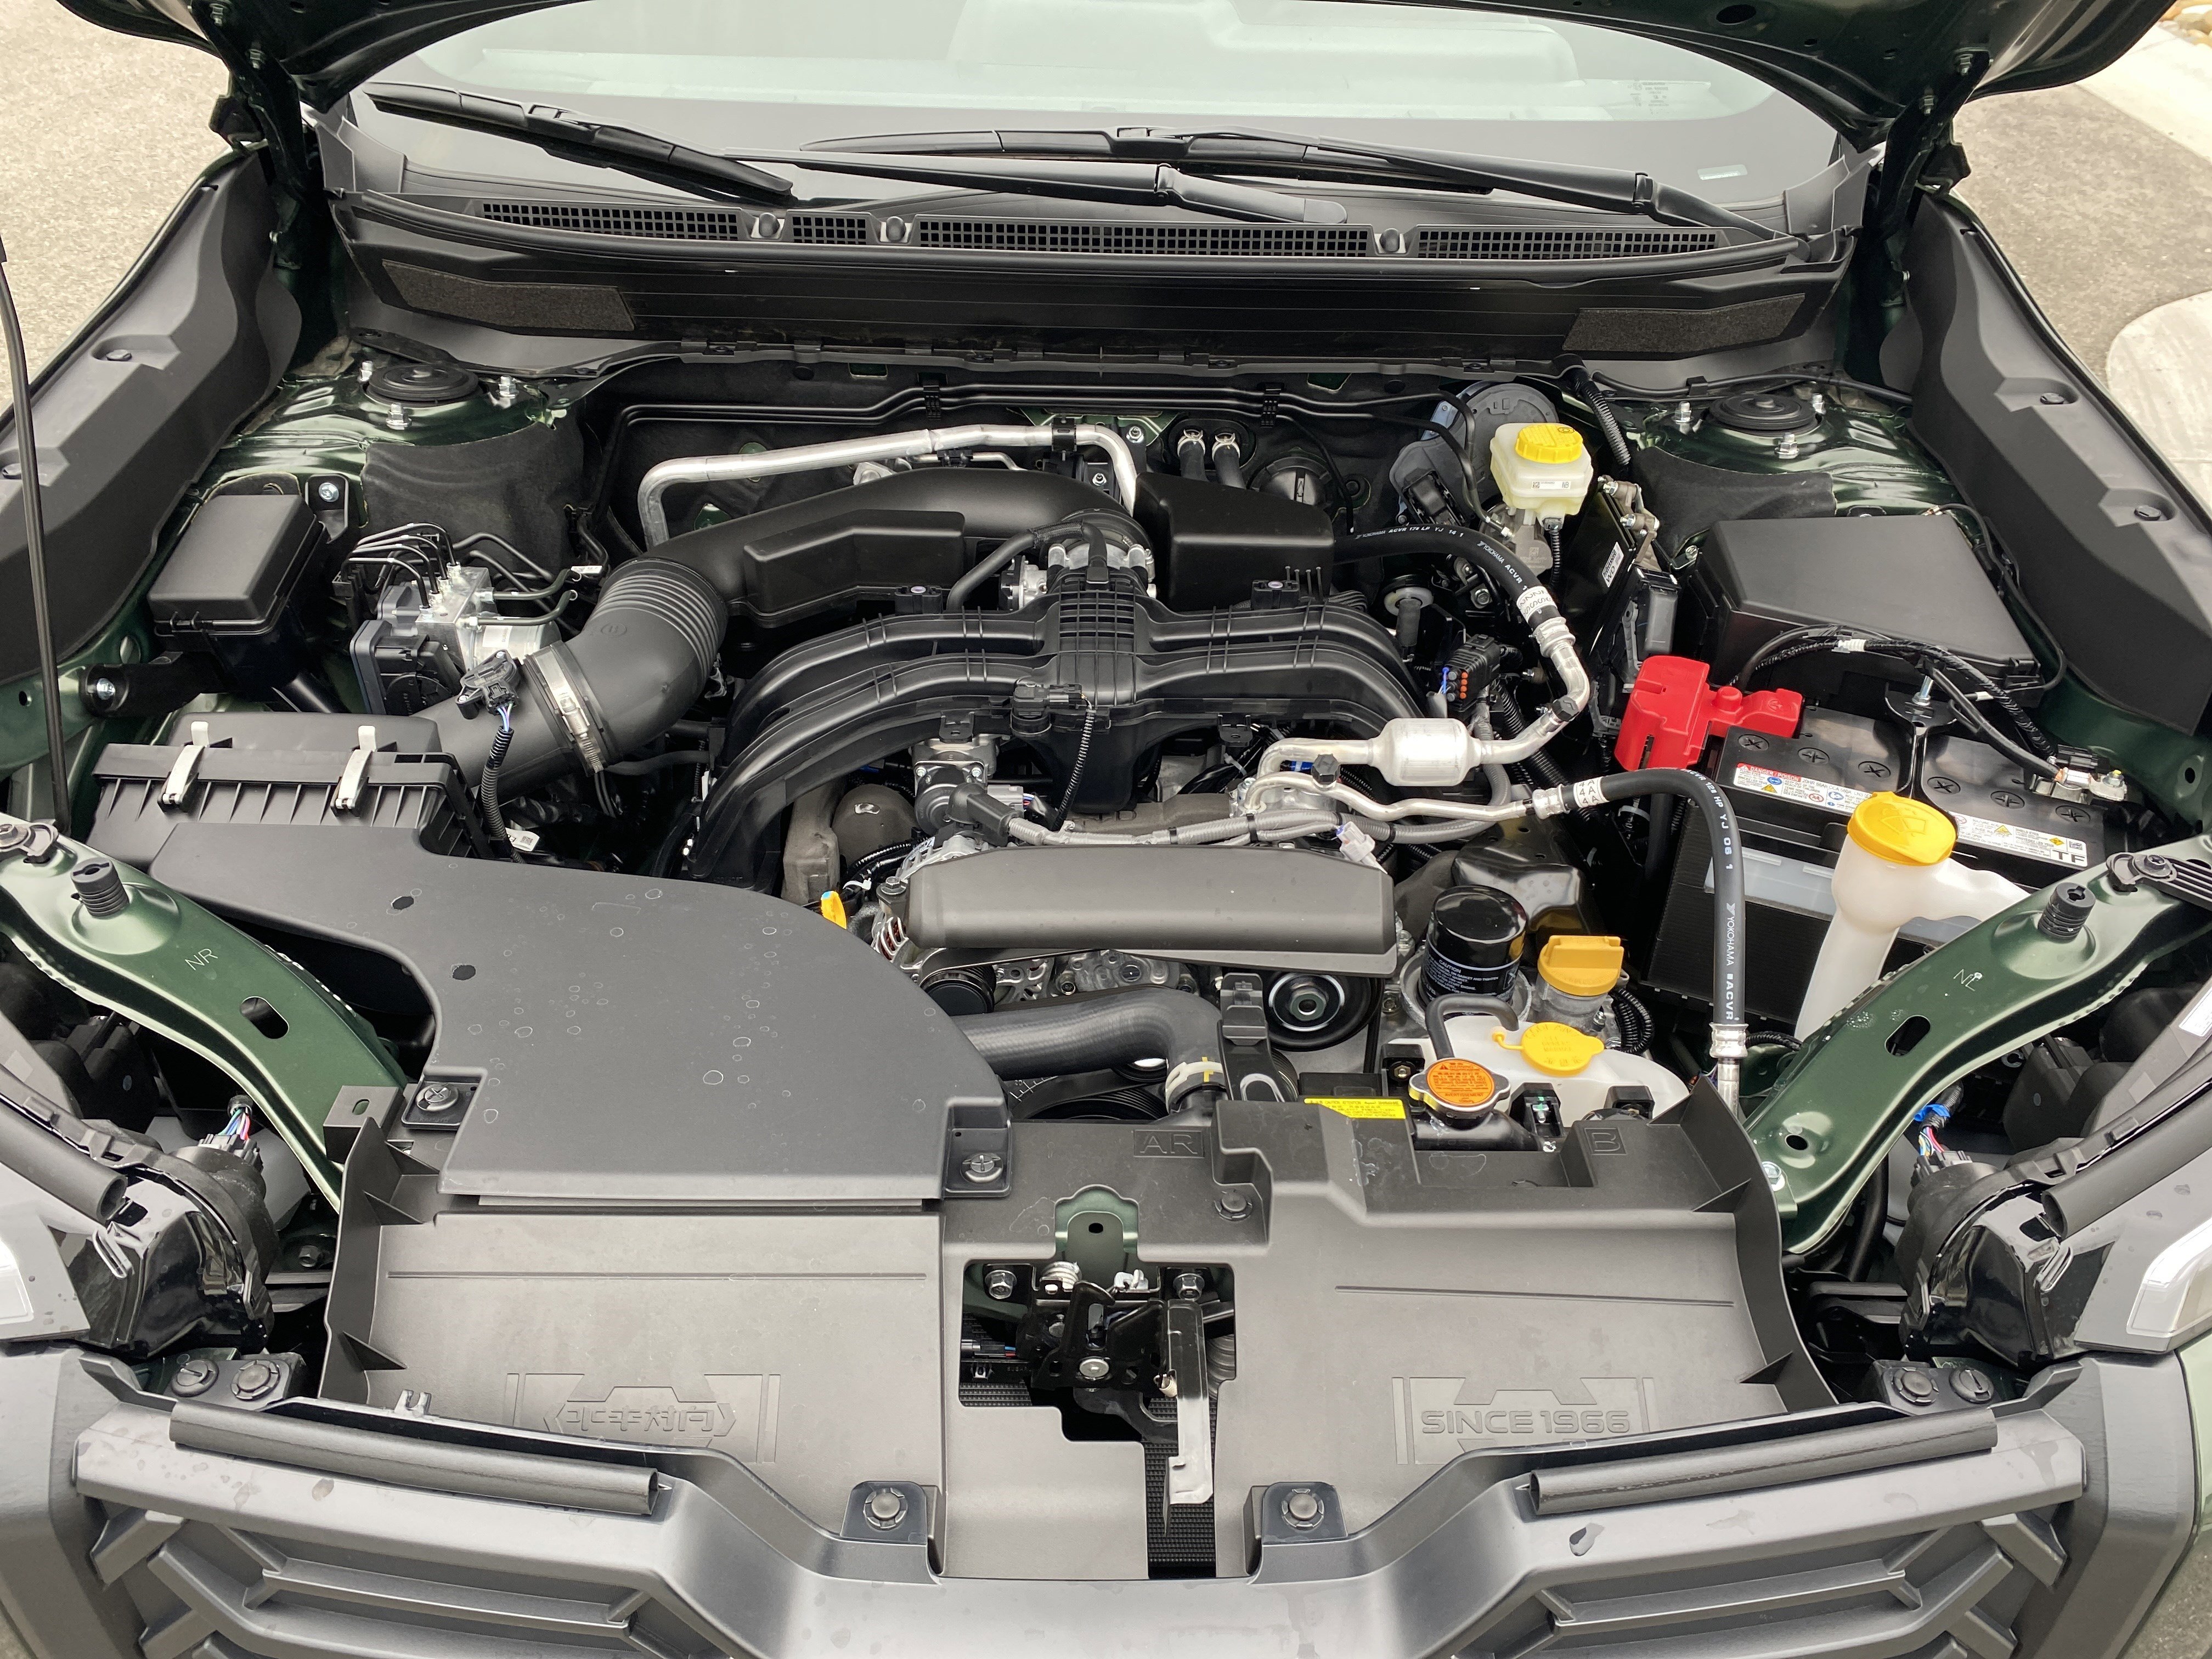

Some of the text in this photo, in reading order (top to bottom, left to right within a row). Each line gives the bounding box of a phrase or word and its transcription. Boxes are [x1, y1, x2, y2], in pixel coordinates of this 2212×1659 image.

[1483, 545, 1505, 564] YOKOHAMA
[1505, 565, 1523, 584] ACVR
[1750, 766, 1774, 776] DANGER
[1778, 772, 1799, 782] POISON
[1713, 796, 1724, 808] HP
[1720, 814, 1729, 829] YJ
[1724, 837, 1733, 855] 06
[2052, 849, 2085, 863] TF
[1726, 916, 1735, 966] YOKOHAMA
[184, 947, 219, 972] NR
[1439, 960, 1462, 974] CAUTION
[1140, 1134, 1198, 1154] AR
[1592, 1131, 1621, 1153] B
[1421, 1410, 1630, 1434] SINCE 1966
